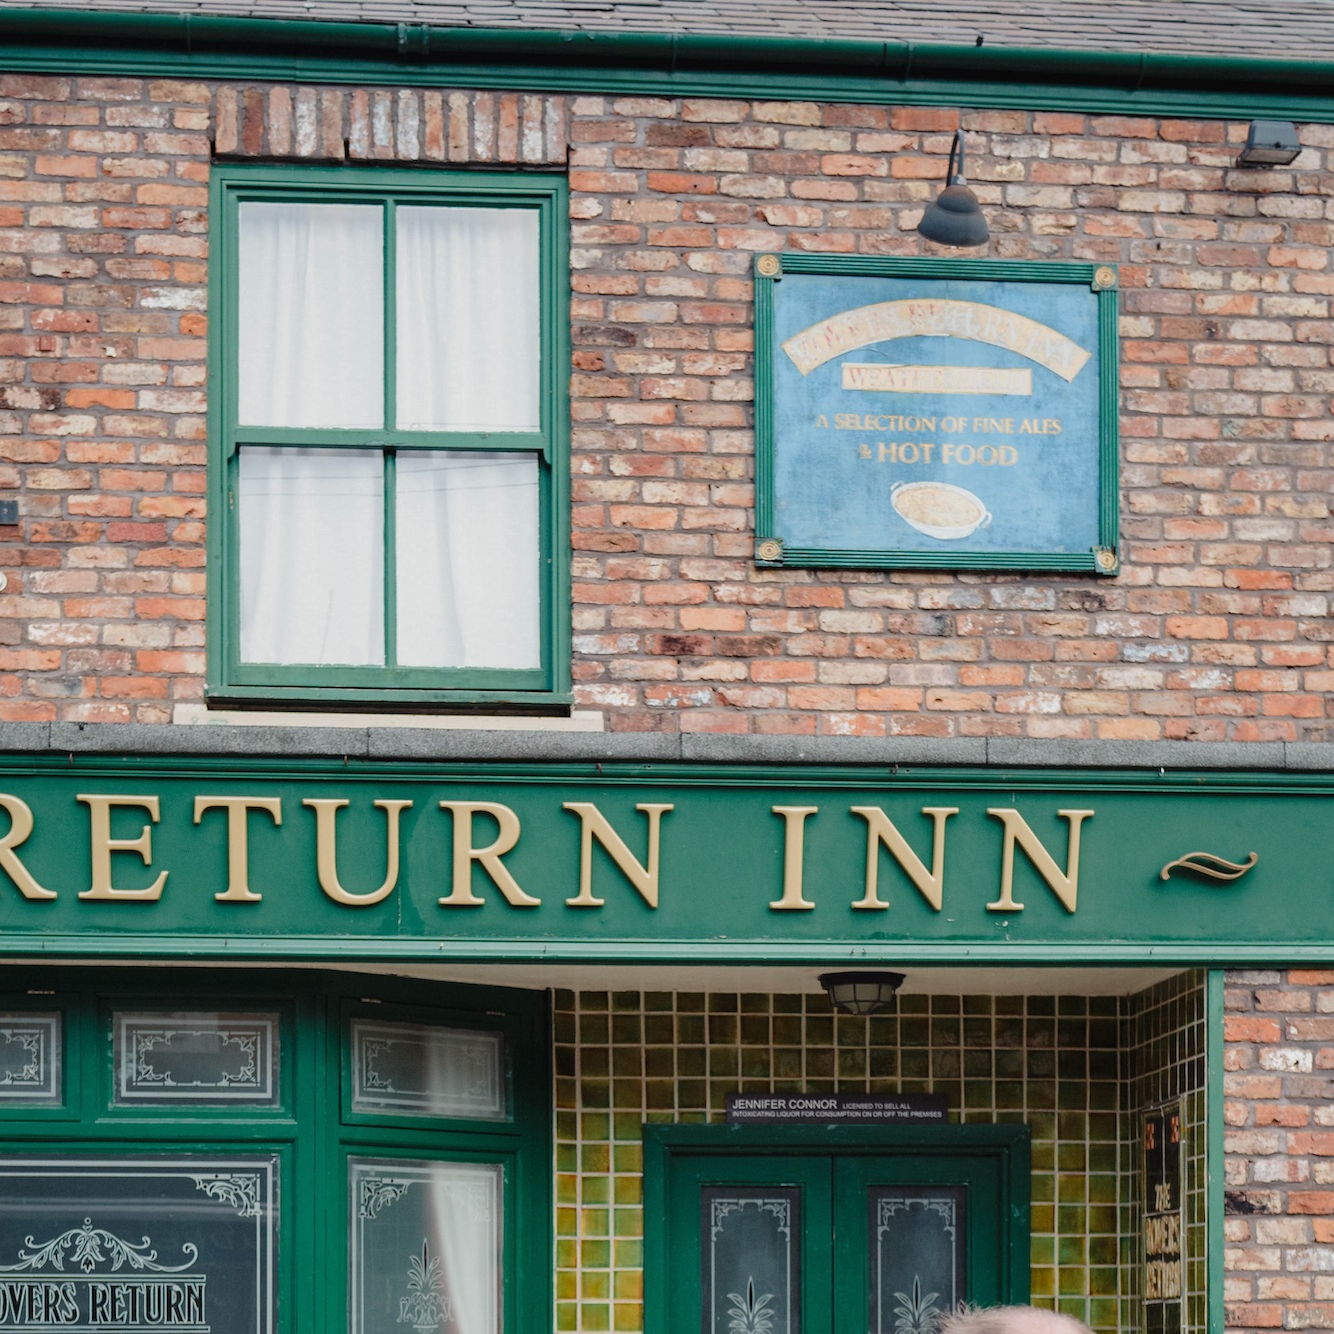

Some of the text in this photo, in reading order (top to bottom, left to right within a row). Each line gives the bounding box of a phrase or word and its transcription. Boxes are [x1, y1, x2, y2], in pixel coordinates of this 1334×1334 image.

[815, 413, 1062, 435] A SELECTION OF FINE ALES
[858, 442, 1019, 466] & HOT FOOD
[770, 804, 1095, 913] INN
[732, 1099, 786, 1110] JENNIFER
[788, 1099, 837, 1110] CONNOR
[1154, 1183, 1171, 1212] THE
[88, 1282, 205, 1325] RETURN
